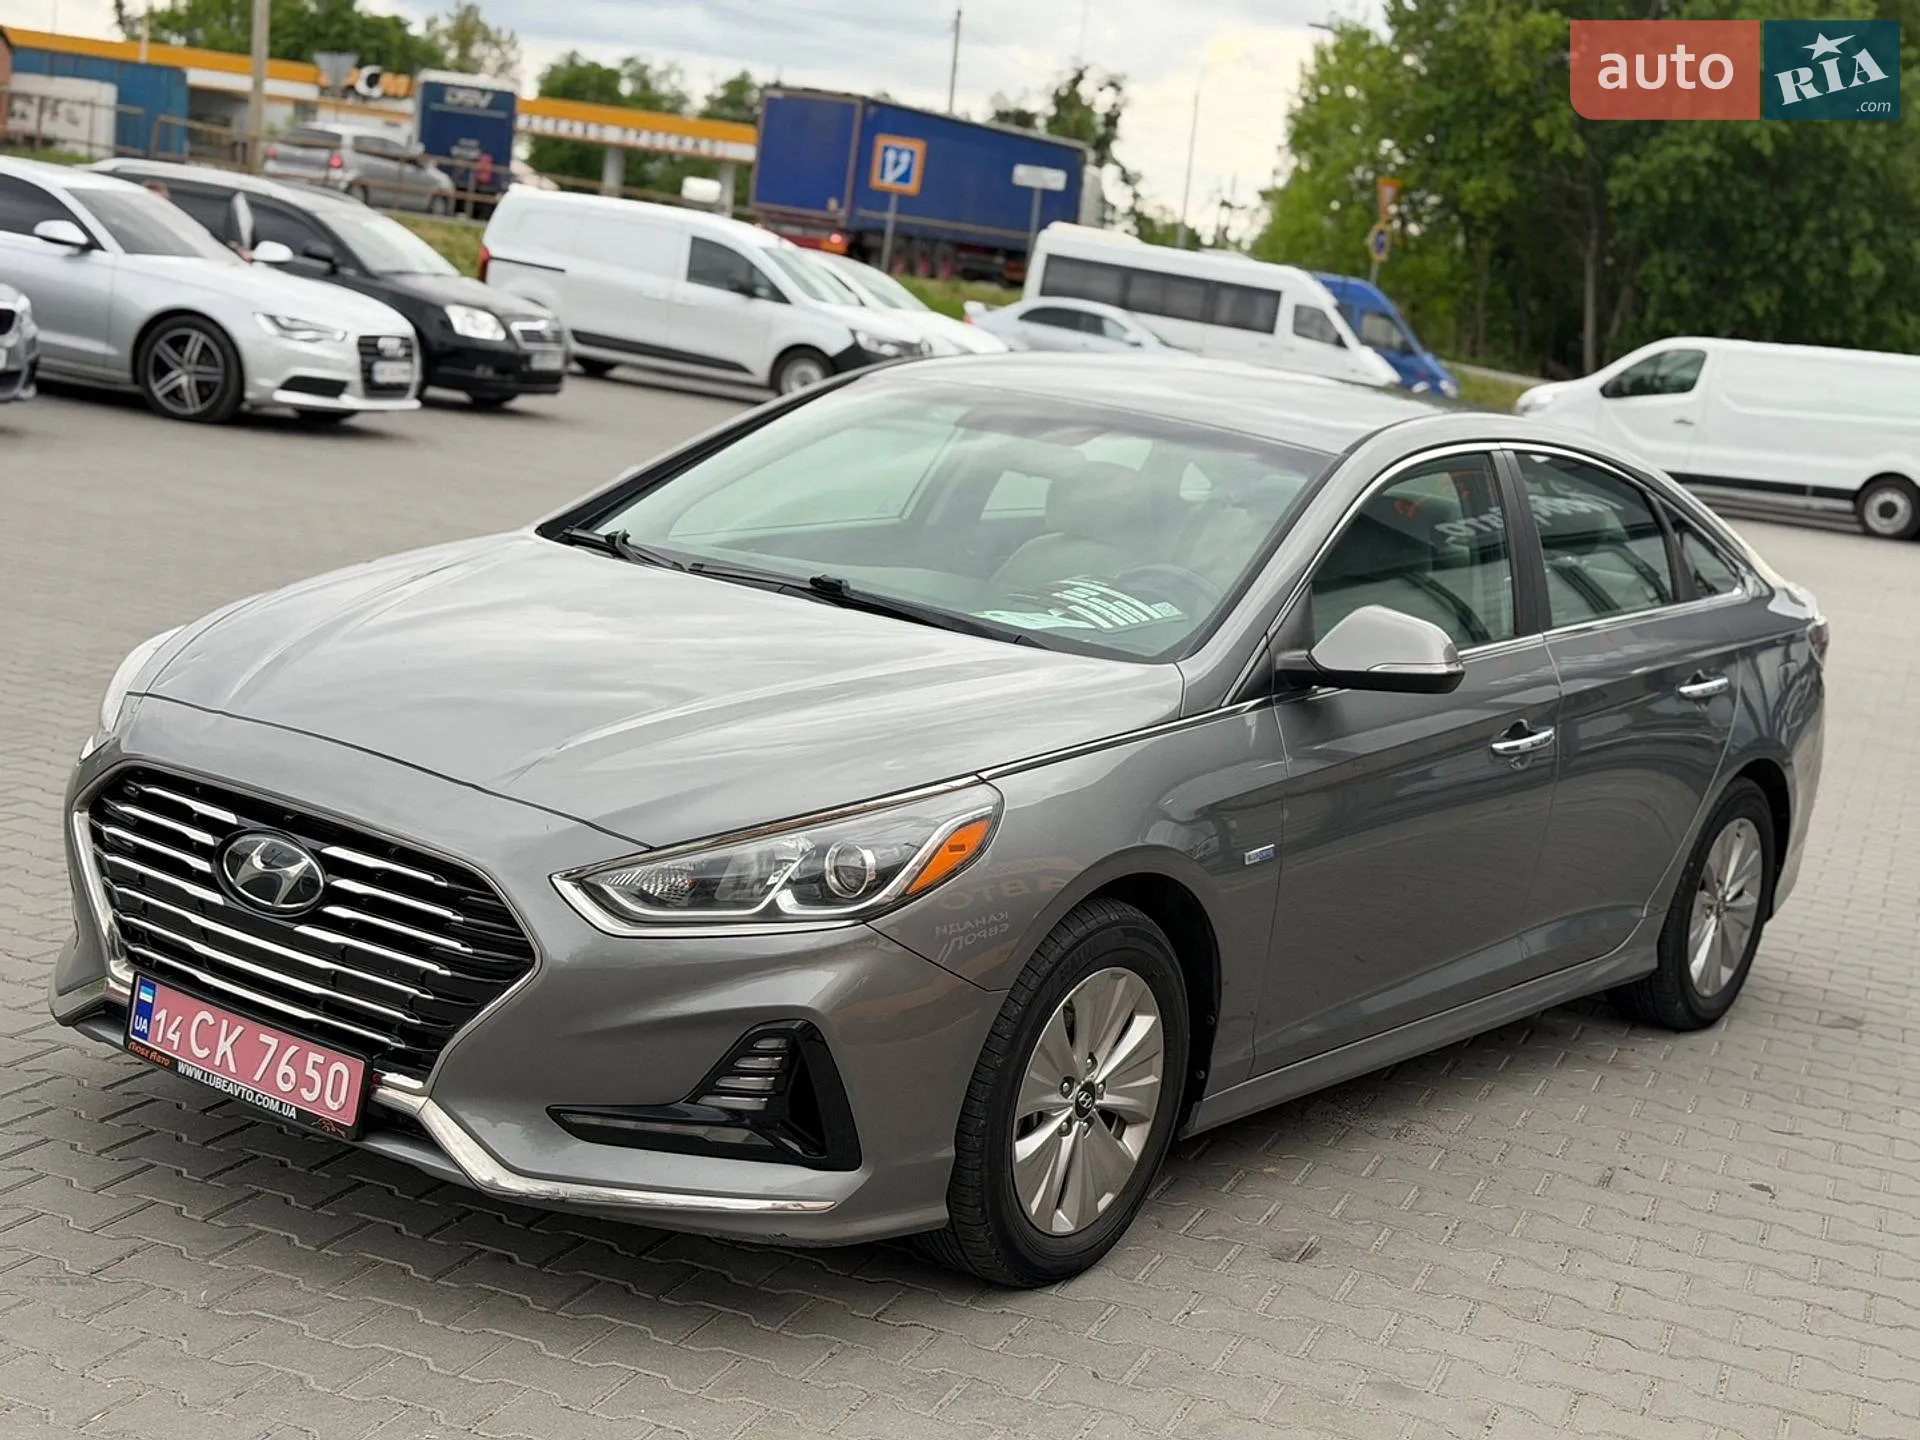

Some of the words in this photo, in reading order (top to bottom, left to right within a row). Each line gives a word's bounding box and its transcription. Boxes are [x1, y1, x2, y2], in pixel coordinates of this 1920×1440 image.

[134, 1017, 148, 1034] UA
[177, 1060, 297, 1120] WWW.LUBEAVTO.COM.UA
[253, 1033, 349, 1111] 7650
